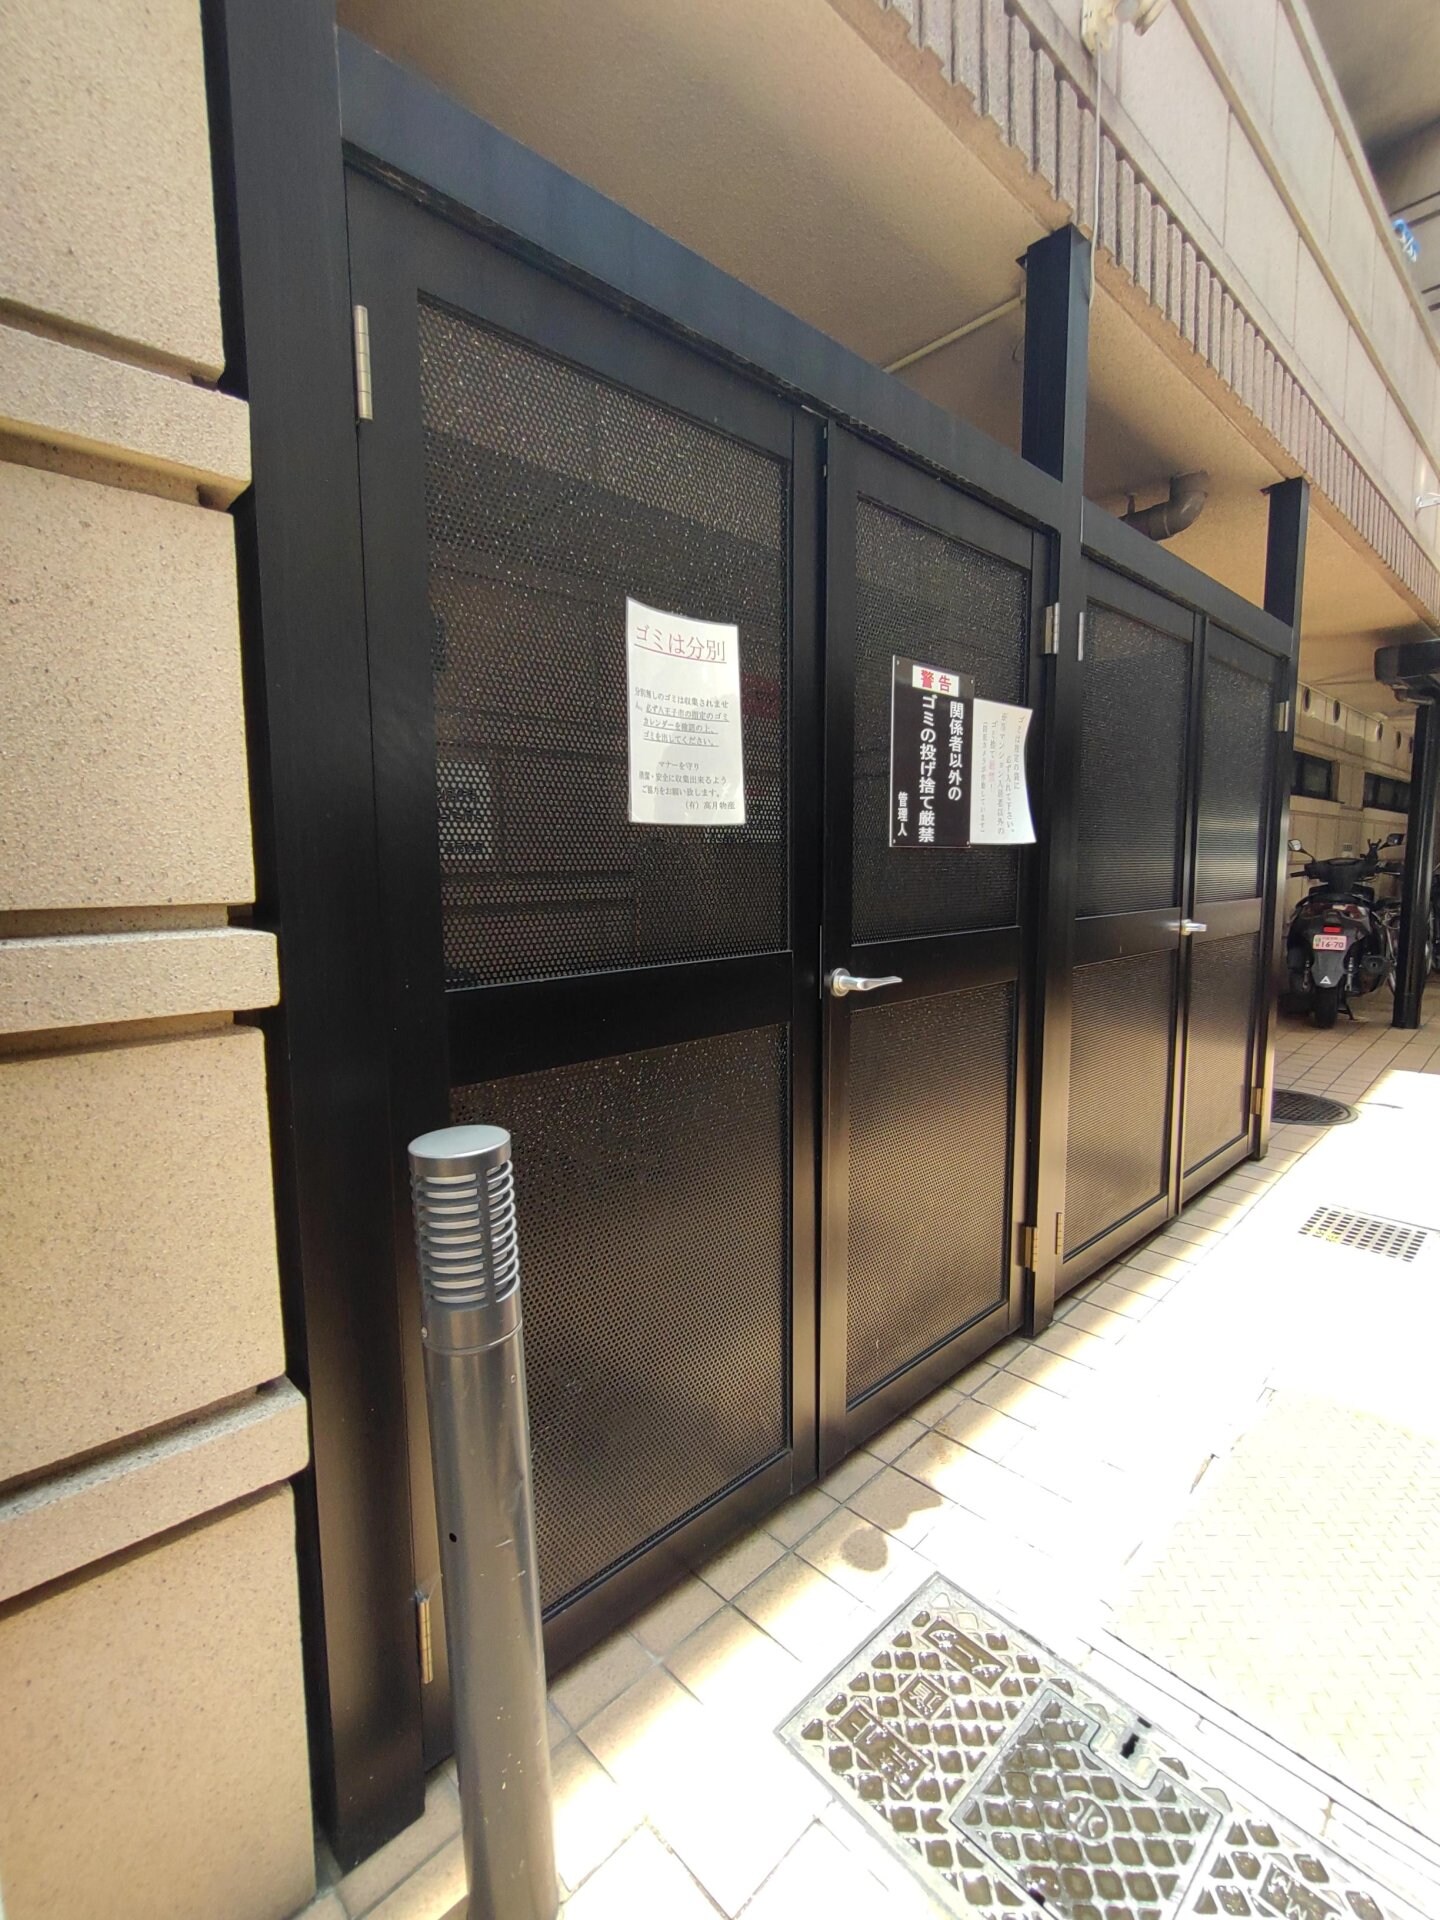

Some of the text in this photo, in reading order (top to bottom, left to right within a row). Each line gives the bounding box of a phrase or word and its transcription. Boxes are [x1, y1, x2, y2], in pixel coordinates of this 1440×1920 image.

[635, 624, 725, 661] ゴミは分別
[920, 669, 951, 693] 警告
[658, 760, 699, 771] マナーを守り
[918, 694, 938, 843] ゴミの投げ捨て厳禁
[947, 701, 964, 801] 関係者以外の
[897, 791, 908, 837] 管理人
